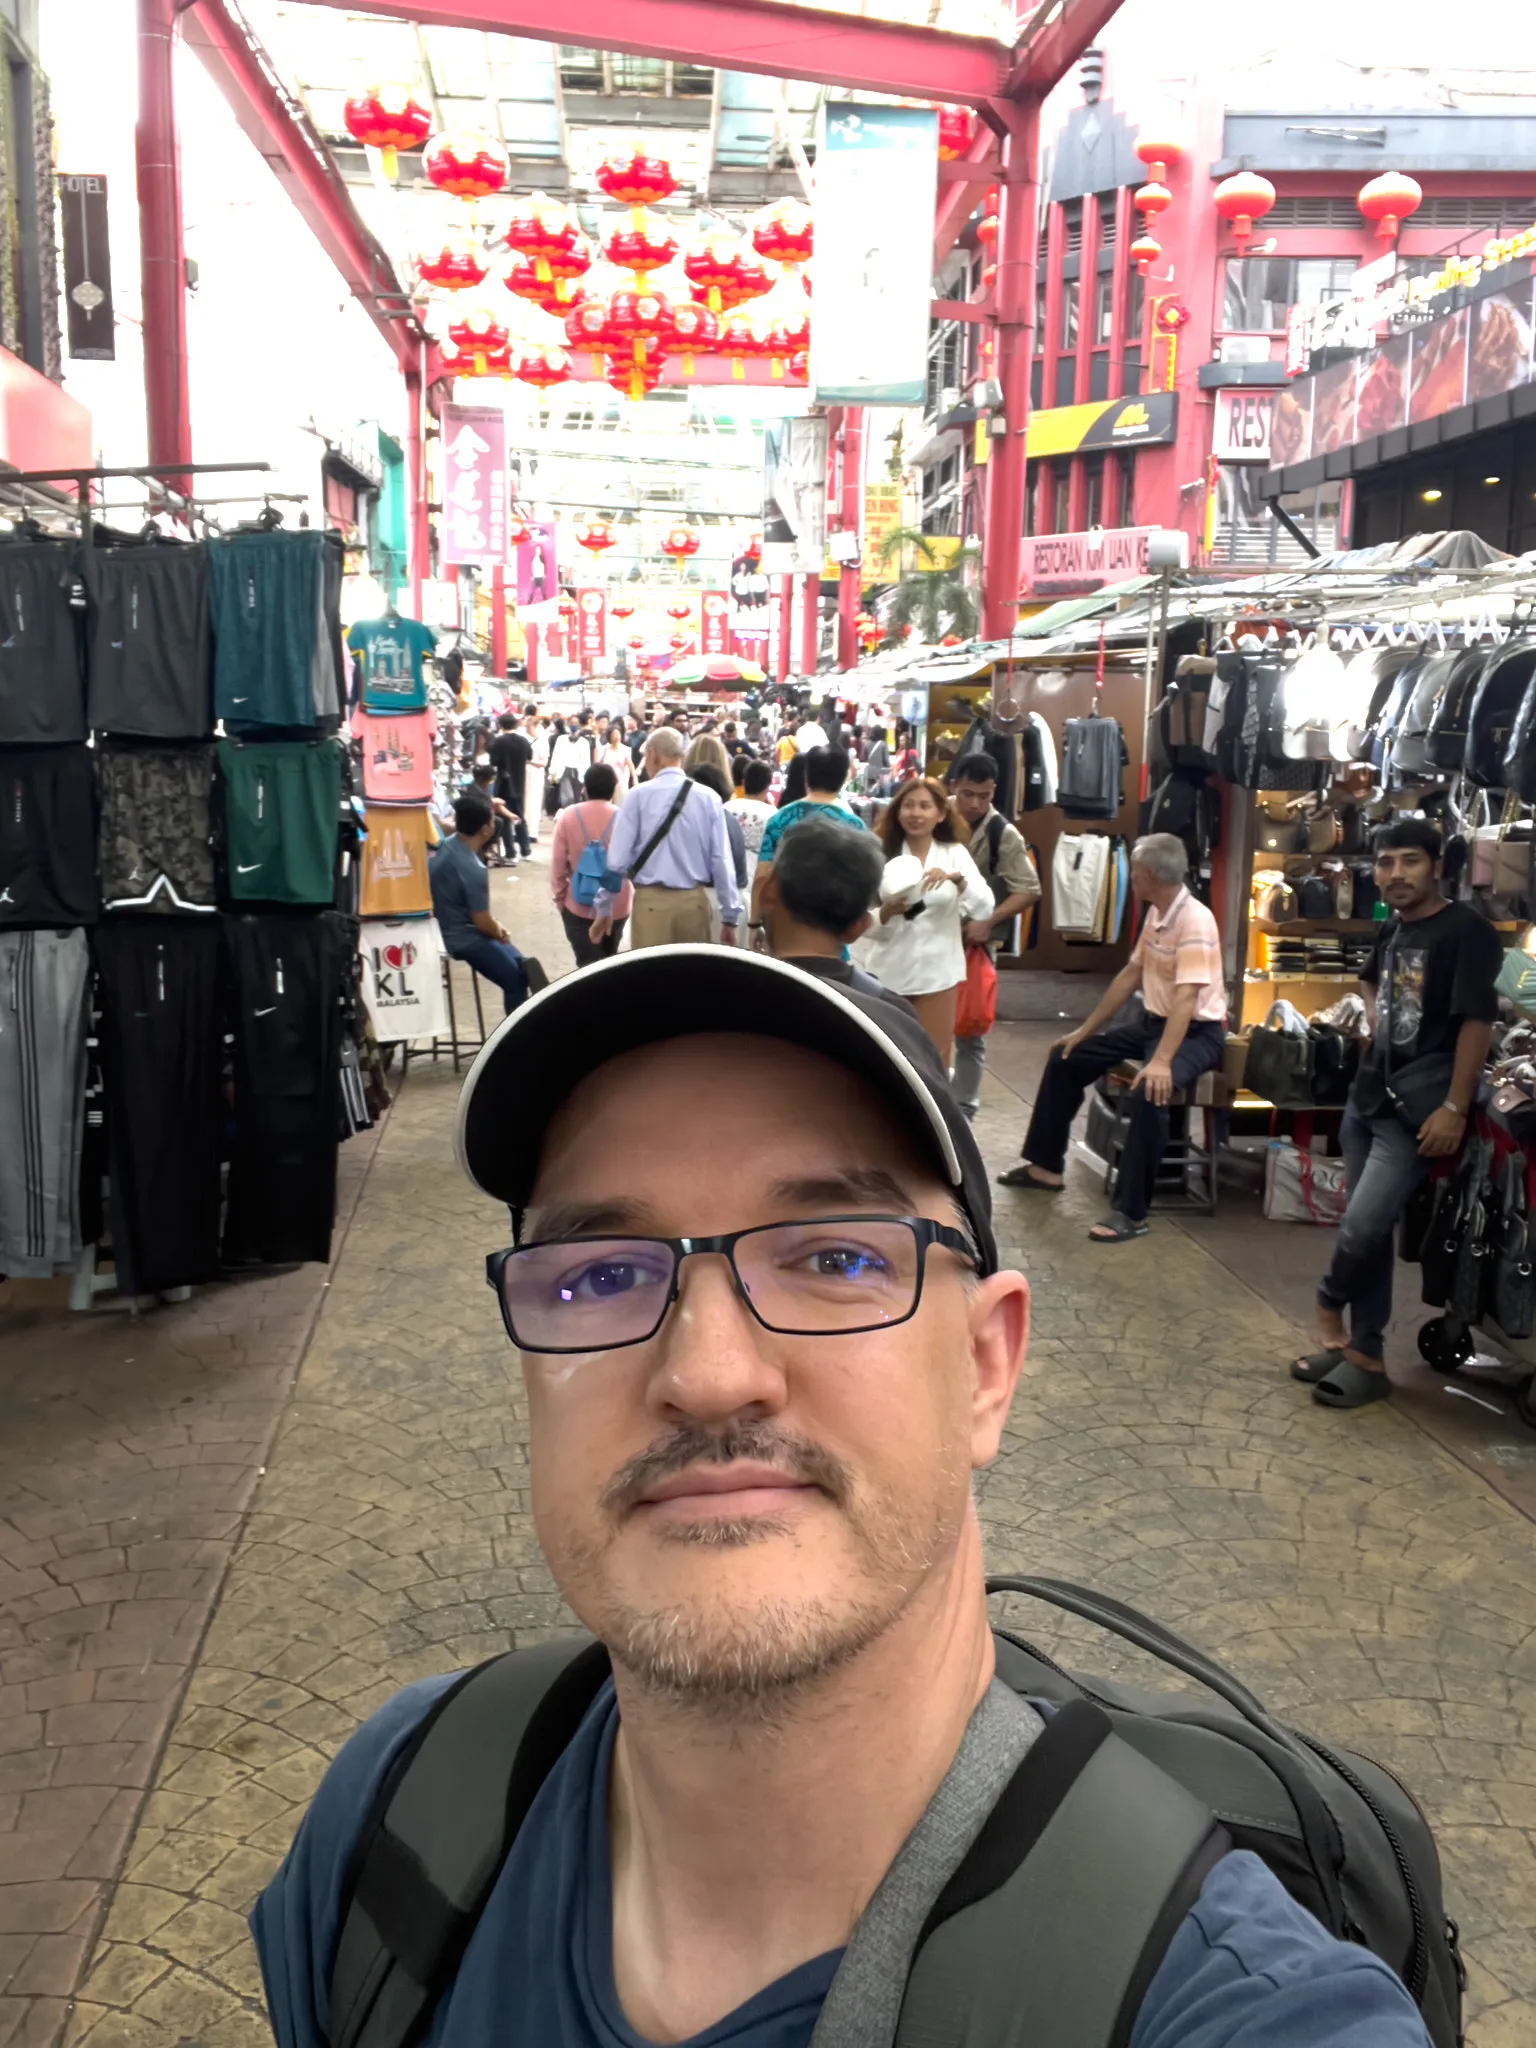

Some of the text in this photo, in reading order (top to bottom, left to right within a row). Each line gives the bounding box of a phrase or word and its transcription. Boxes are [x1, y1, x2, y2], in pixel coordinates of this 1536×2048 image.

[60, 176, 104, 193] HOTEL
[1033, 539, 1083, 575] RESTORAN
[372, 947, 381, 972] I
[374, 971, 414, 999] KL
[376, 997, 421, 1008] MALAYSIA
